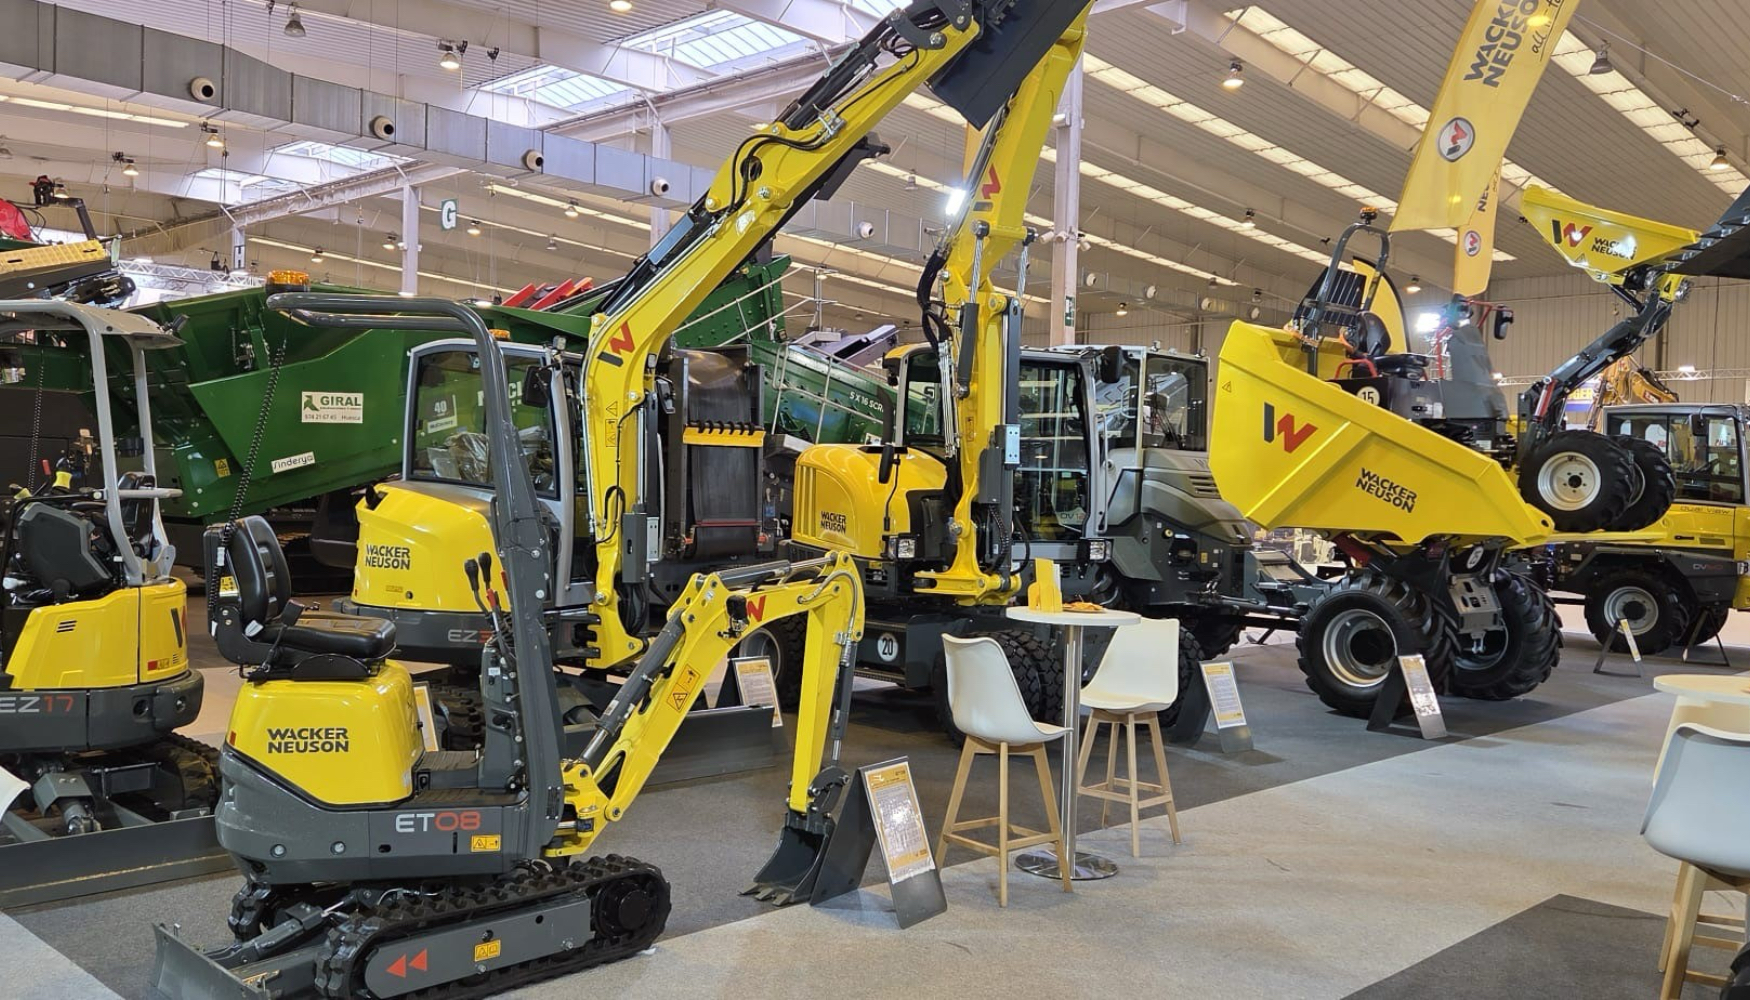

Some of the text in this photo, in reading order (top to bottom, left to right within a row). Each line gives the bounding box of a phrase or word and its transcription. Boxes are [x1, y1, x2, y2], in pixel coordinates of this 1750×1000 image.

[442, 200, 456, 230] G
[320, 396, 361, 407] GIRAL
[1362, 391, 1375, 404] 15
[434, 400, 447, 413] 40
[869, 400, 884, 412] SCR
[1361, 467, 1418, 503] WACKER
[1355, 478, 1415, 513] NEUSON
[821, 510, 846, 523] WACKER
[820, 520, 846, 534] NEUSON
[365, 544, 411, 559] WACKER
[365, 556, 411, 570] NEUSON
[882, 637, 894, 656] 20
[0, 696, 74, 713] EZ17
[267, 727, 349, 741] WACKER
[267, 740, 349, 754] NEUSON
[395, 810, 481, 832] ET08
